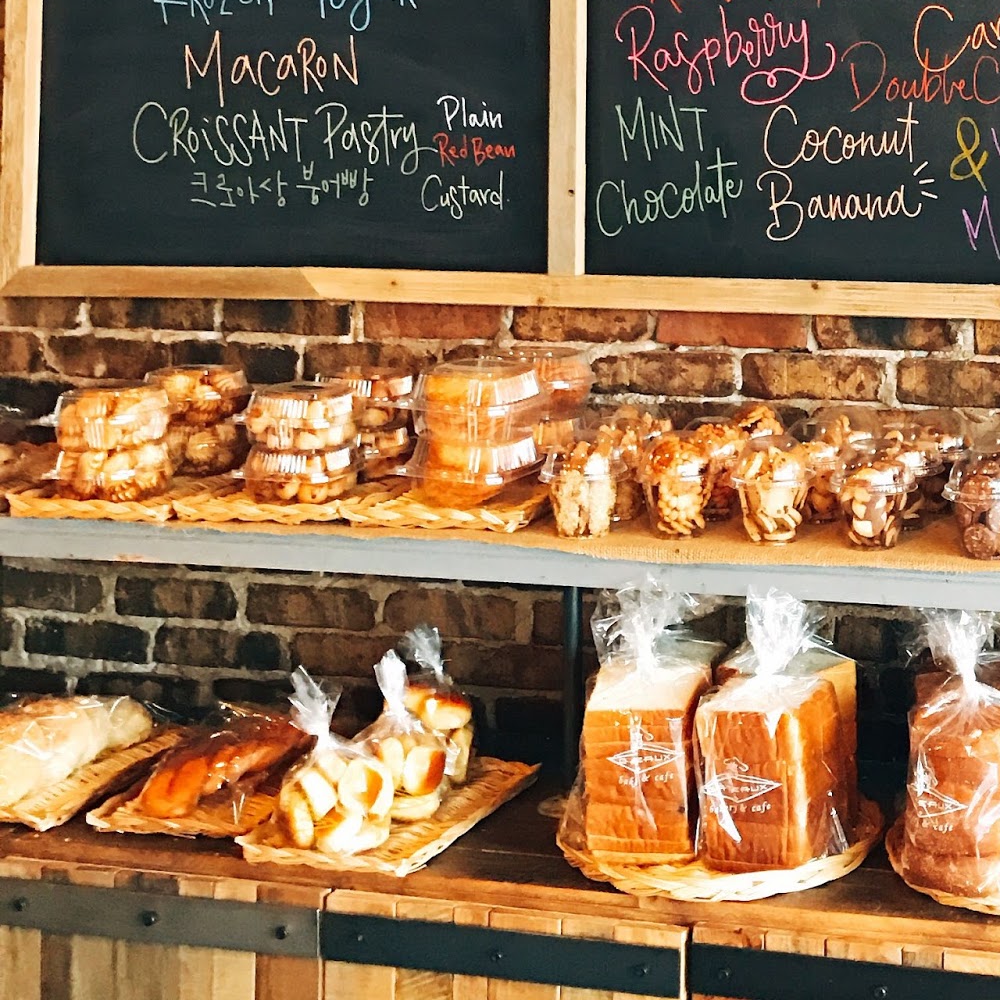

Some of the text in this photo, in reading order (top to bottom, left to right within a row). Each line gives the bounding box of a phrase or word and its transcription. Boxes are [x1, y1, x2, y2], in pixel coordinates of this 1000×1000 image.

[616, 5, 835, 105] Raspberry
[842, 41, 975, 111] Double
[316, 103, 438, 173] Pastry
[437, 95, 502, 131] Plain
[615, 95, 707, 161] MINT
[764, 102, 918, 168] Coconut
[296, 161, 374, 206] 붕어빵
[433, 133, 515, 166] Red Bean
[950, 117, 988, 191] &
[598, 148, 742, 236] Chocolate
[757, 170, 922, 241] Banana
